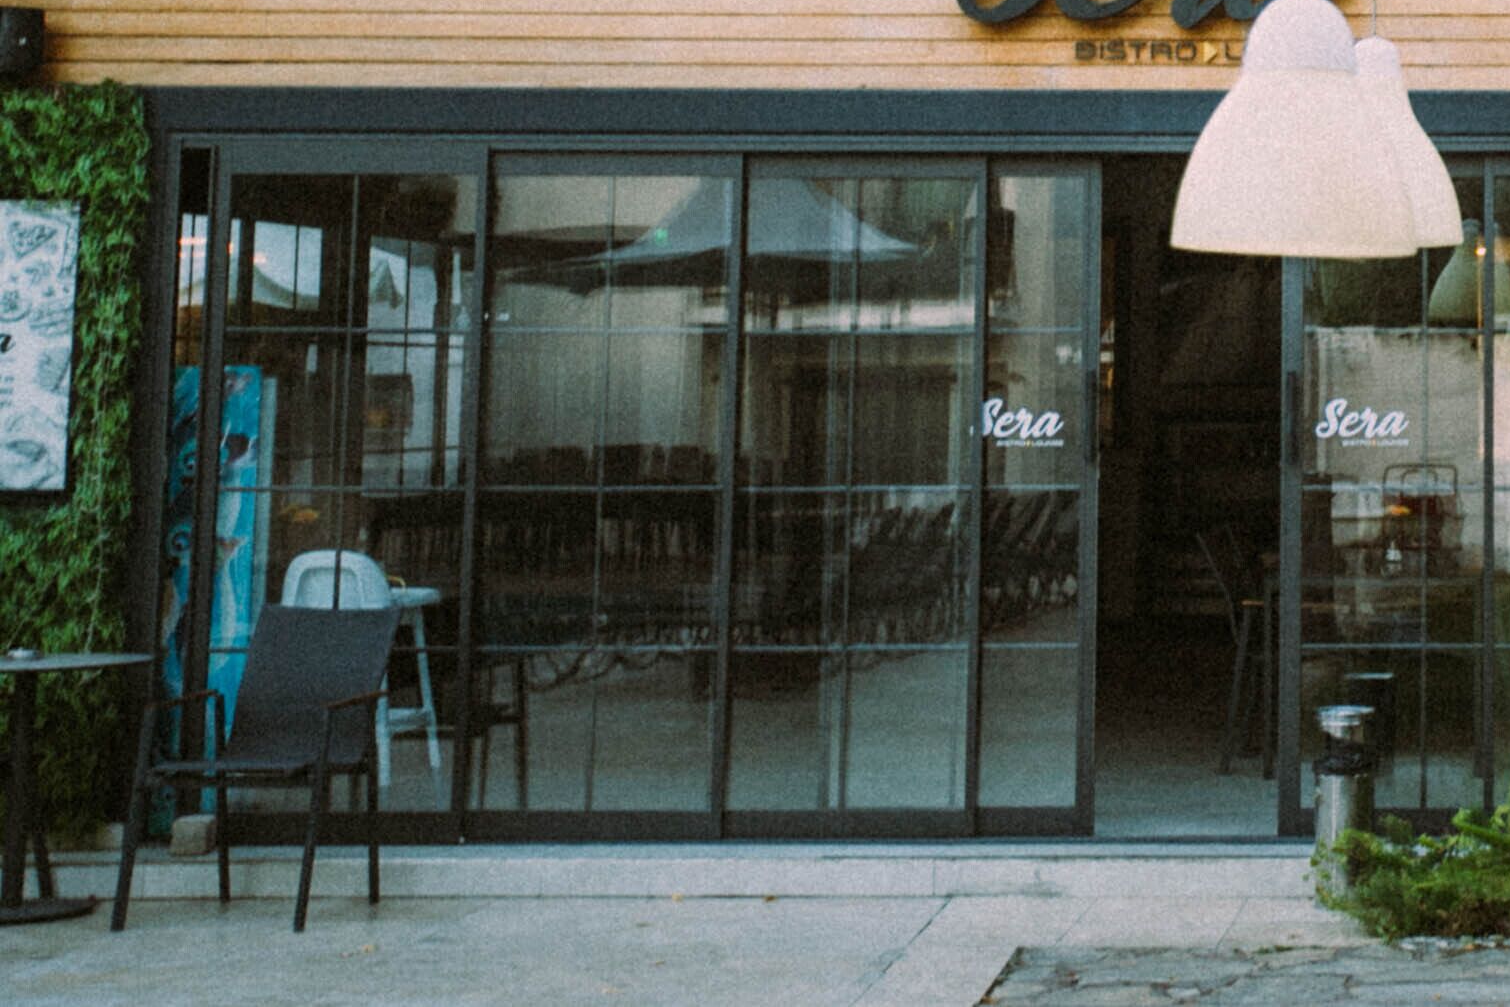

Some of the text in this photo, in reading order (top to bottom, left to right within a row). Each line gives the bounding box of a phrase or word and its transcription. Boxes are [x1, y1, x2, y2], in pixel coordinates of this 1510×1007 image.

[1074, 39, 1198, 62] BISTRO
[970, 398, 1065, 439] Sera
[1315, 397, 1410, 439] Sera
